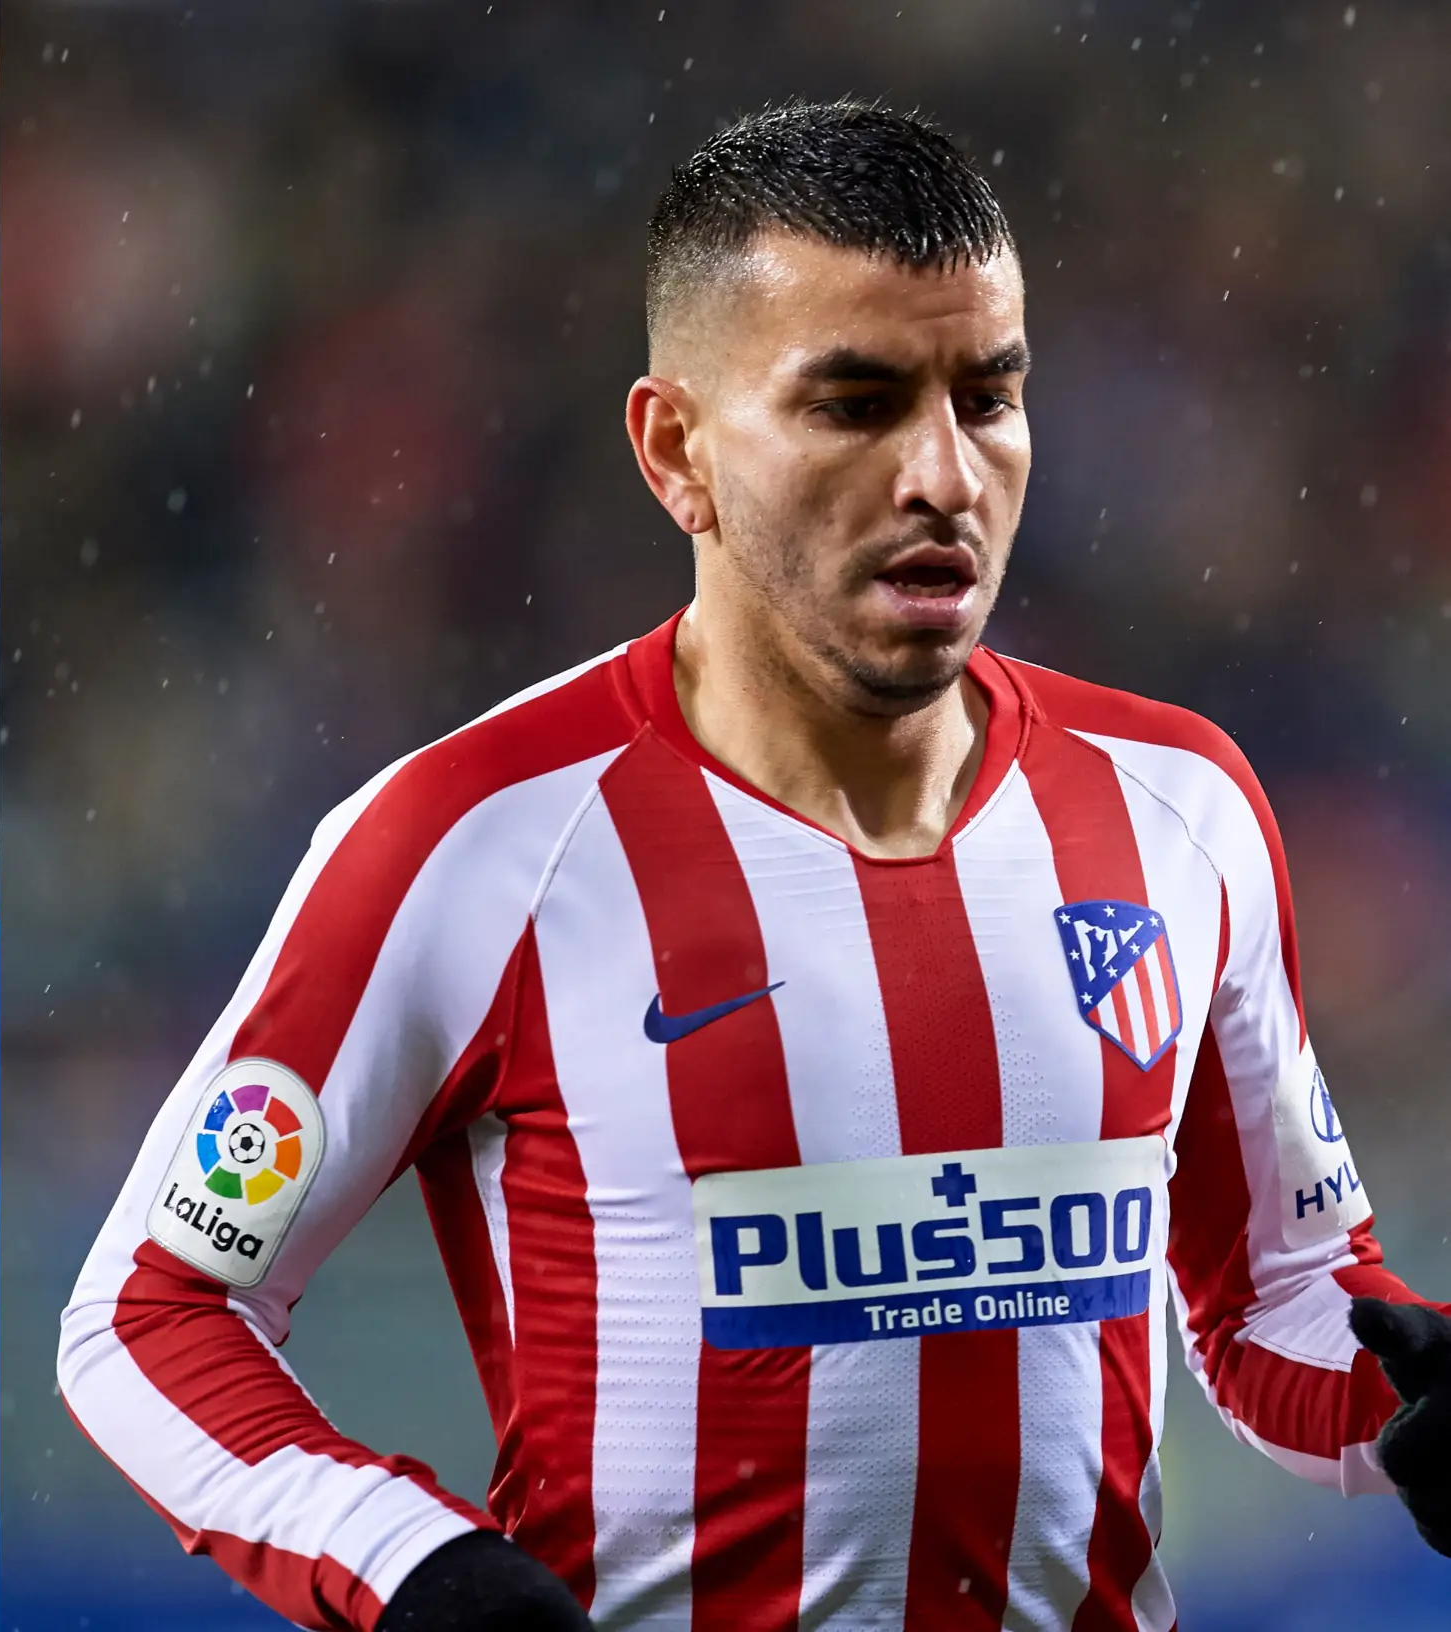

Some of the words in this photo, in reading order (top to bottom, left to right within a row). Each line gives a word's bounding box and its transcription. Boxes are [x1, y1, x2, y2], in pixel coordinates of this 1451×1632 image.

[163, 1182, 264, 1260] LaLiga
[710, 1187, 1152, 1297] Plus500
[864, 1302, 963, 1332] Trade
[974, 1293, 1070, 1322] Online
